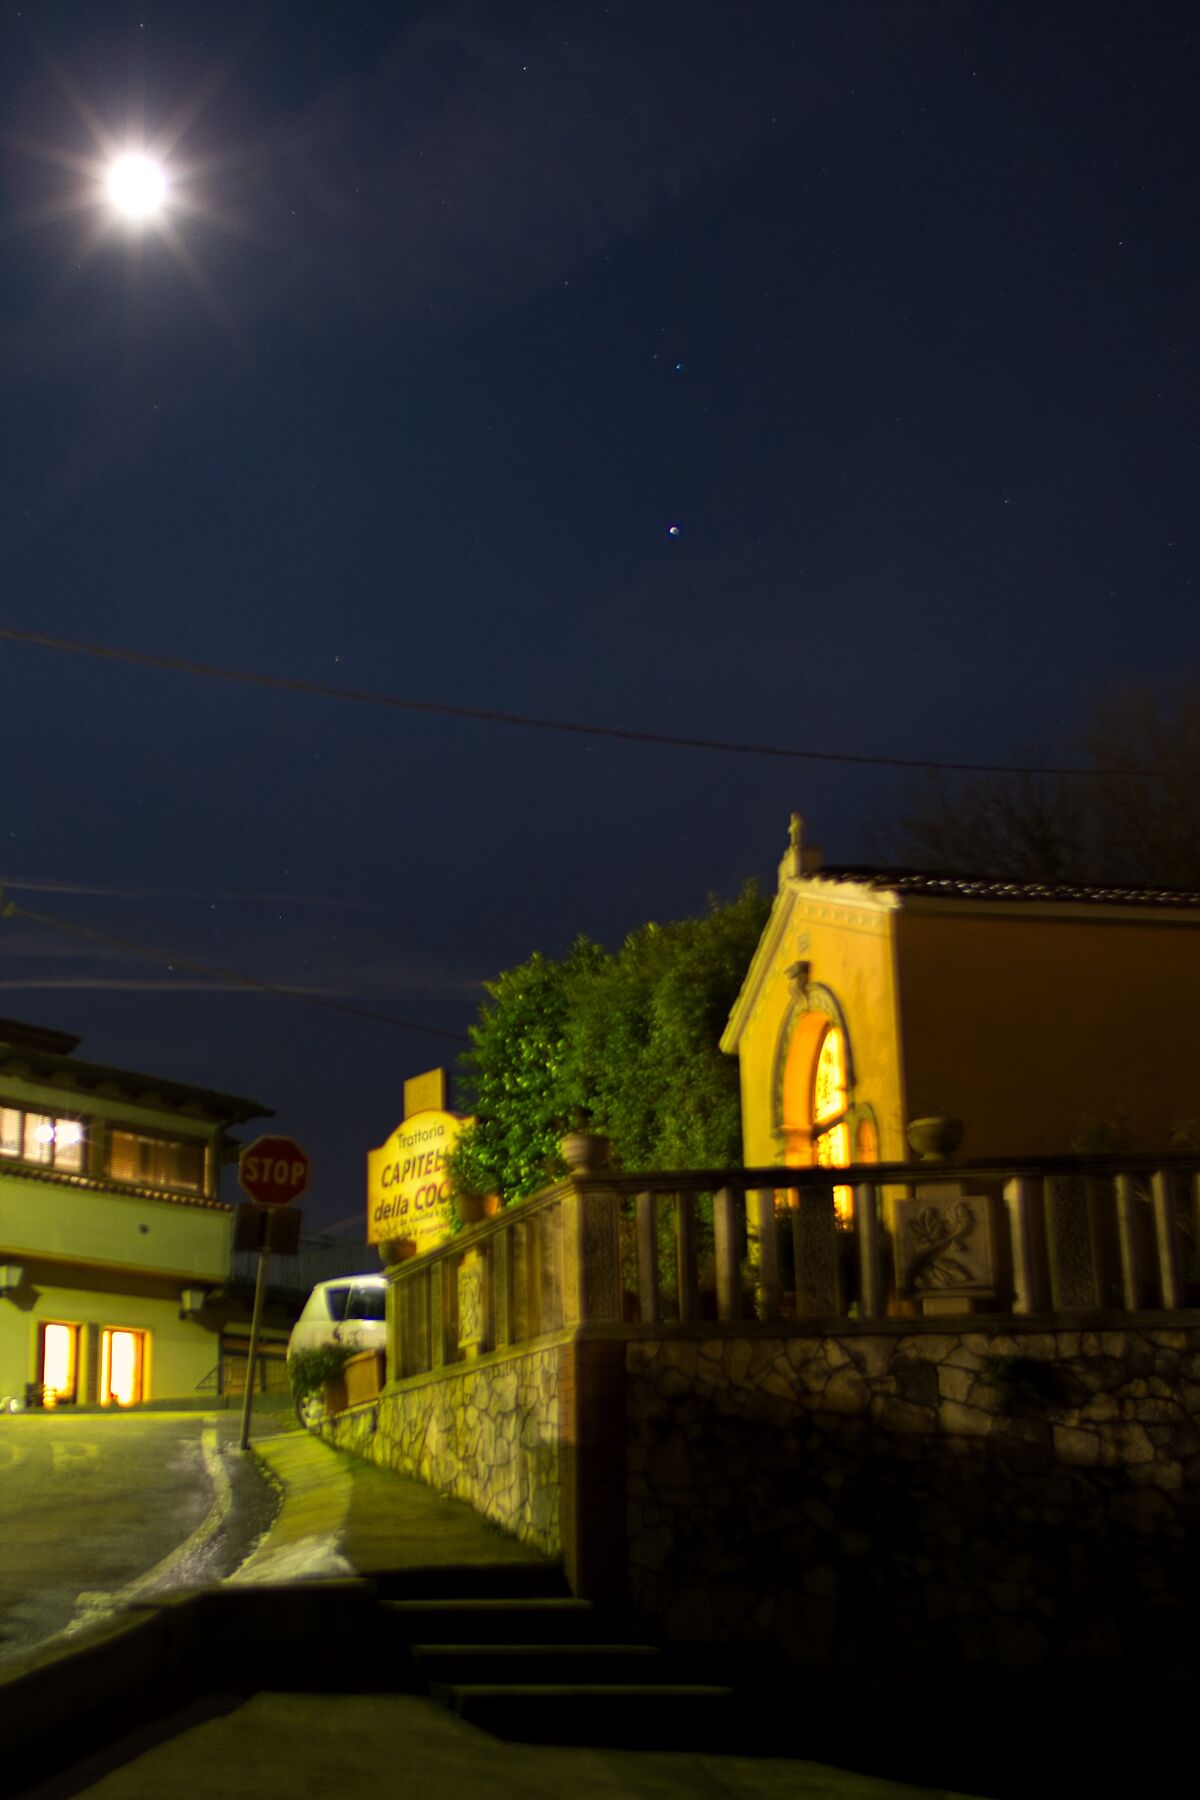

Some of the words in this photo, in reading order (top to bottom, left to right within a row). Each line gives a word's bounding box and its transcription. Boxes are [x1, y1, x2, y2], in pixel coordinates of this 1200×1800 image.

[397, 1121, 445, 1149] Trattoria
[245, 1156, 306, 1186] STOP
[374, 1194, 409, 1222] della
